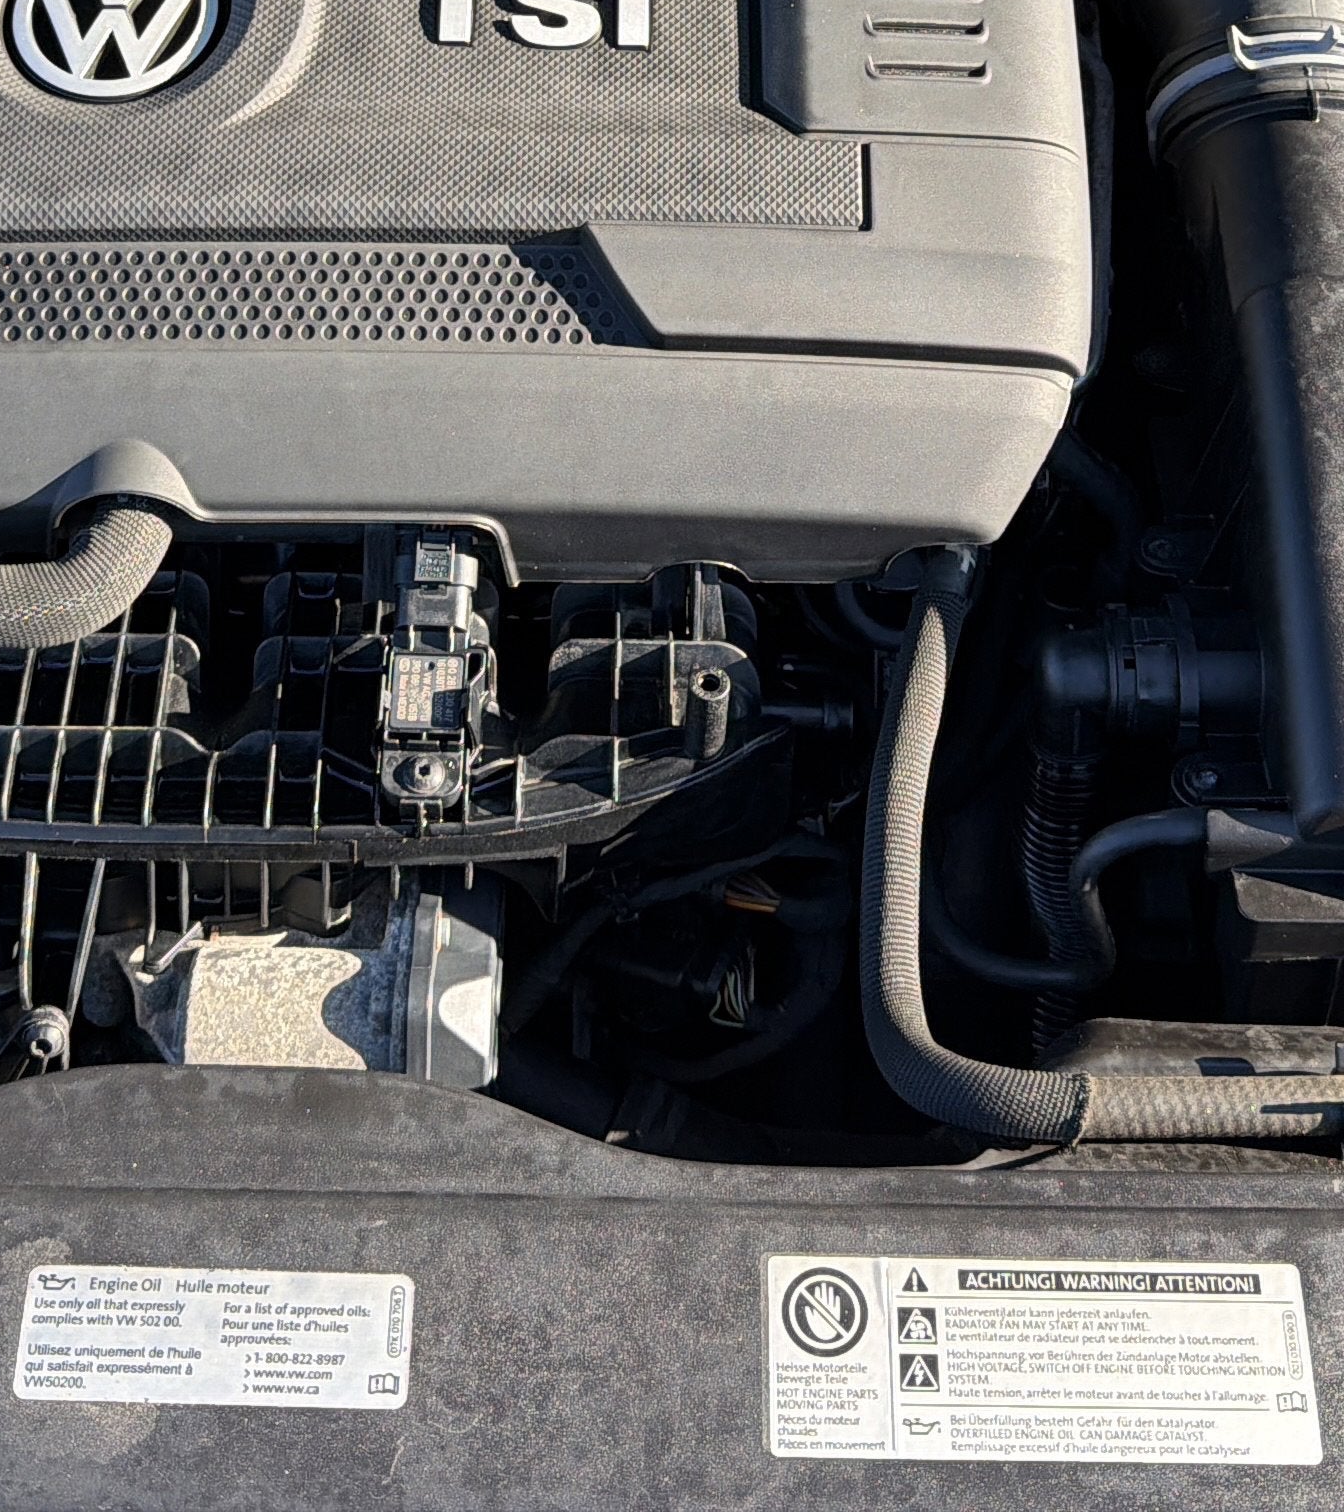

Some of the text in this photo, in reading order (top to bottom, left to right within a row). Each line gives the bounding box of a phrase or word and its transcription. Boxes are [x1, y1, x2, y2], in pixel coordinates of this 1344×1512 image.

[89, 1277, 270, 1295] Engine Oil Huile moteur
[966, 1272, 1255, 1293] ACHTUNG! WARNING! ATTENTION!
[34, 1297, 185, 1316] Use only oil that expressly
[223, 1302, 243, 1314] For
[244, 1304, 252, 1314] a
[254, 1302, 272, 1315] list
[275, 1303, 289, 1315] of
[290, 1304, 344, 1318] approved
[32, 1314, 183, 1328] complies with VW 502 00.
[222, 1318, 248, 1330] Pour
[251, 1321, 273, 1331] une
[276, 1319, 301, 1332] liste
[944, 1319, 997, 1330] RADIATOR
[1000, 1319, 1020, 1330] FAN
[1023, 1320, 1046, 1330] MAY
[1049, 1320, 1078, 1331] START
[1082, 1321, 1094, 1331] AT
[1097, 1321, 1118, 1332] ANY
[27, 1343, 71, 1356] Utilisez
[74, 1345, 146, 1360] uniquement
[148, 1346, 164, 1359] de
[25, 1360, 193, 1376] qui satisfait expressément à
[253, 1370, 333, 1380] www.vw.com
[947, 1362, 975, 1372] HIGH
[1029, 1362, 1070, 1373] SWITCH
[1072, 1363, 1092, 1374] OFF
[1094, 1363, 1133, 1375] ENGINE
[1136, 1364, 1176, 1376] BEFORE
[1179, 1365, 1235, 1376] TOUCHING
[1237, 1366, 1286, 1376] IGNITION
[23, 1375, 87, 1389] VW50200.
[251, 1384, 320, 1395] www.vw.ca
[776, 1388, 879, 1400] HOT ENGINE PARTS
[776, 1399, 859, 1411] MOVING PARTS
[808, 1414, 822, 1425] du
[824, 1415, 860, 1426] moteur
[950, 1428, 1013, 1439] OVERFILLED
[1015, 1429, 1054, 1440] ENGINE
[1057, 1429, 1075, 1440] OIL
[1079, 1430, 1103, 1440] CAN
[1105, 1430, 1153, 1442] DAMAGE
[809, 1440, 822, 1449] en
[824, 1440, 886, 1451] mouvement
